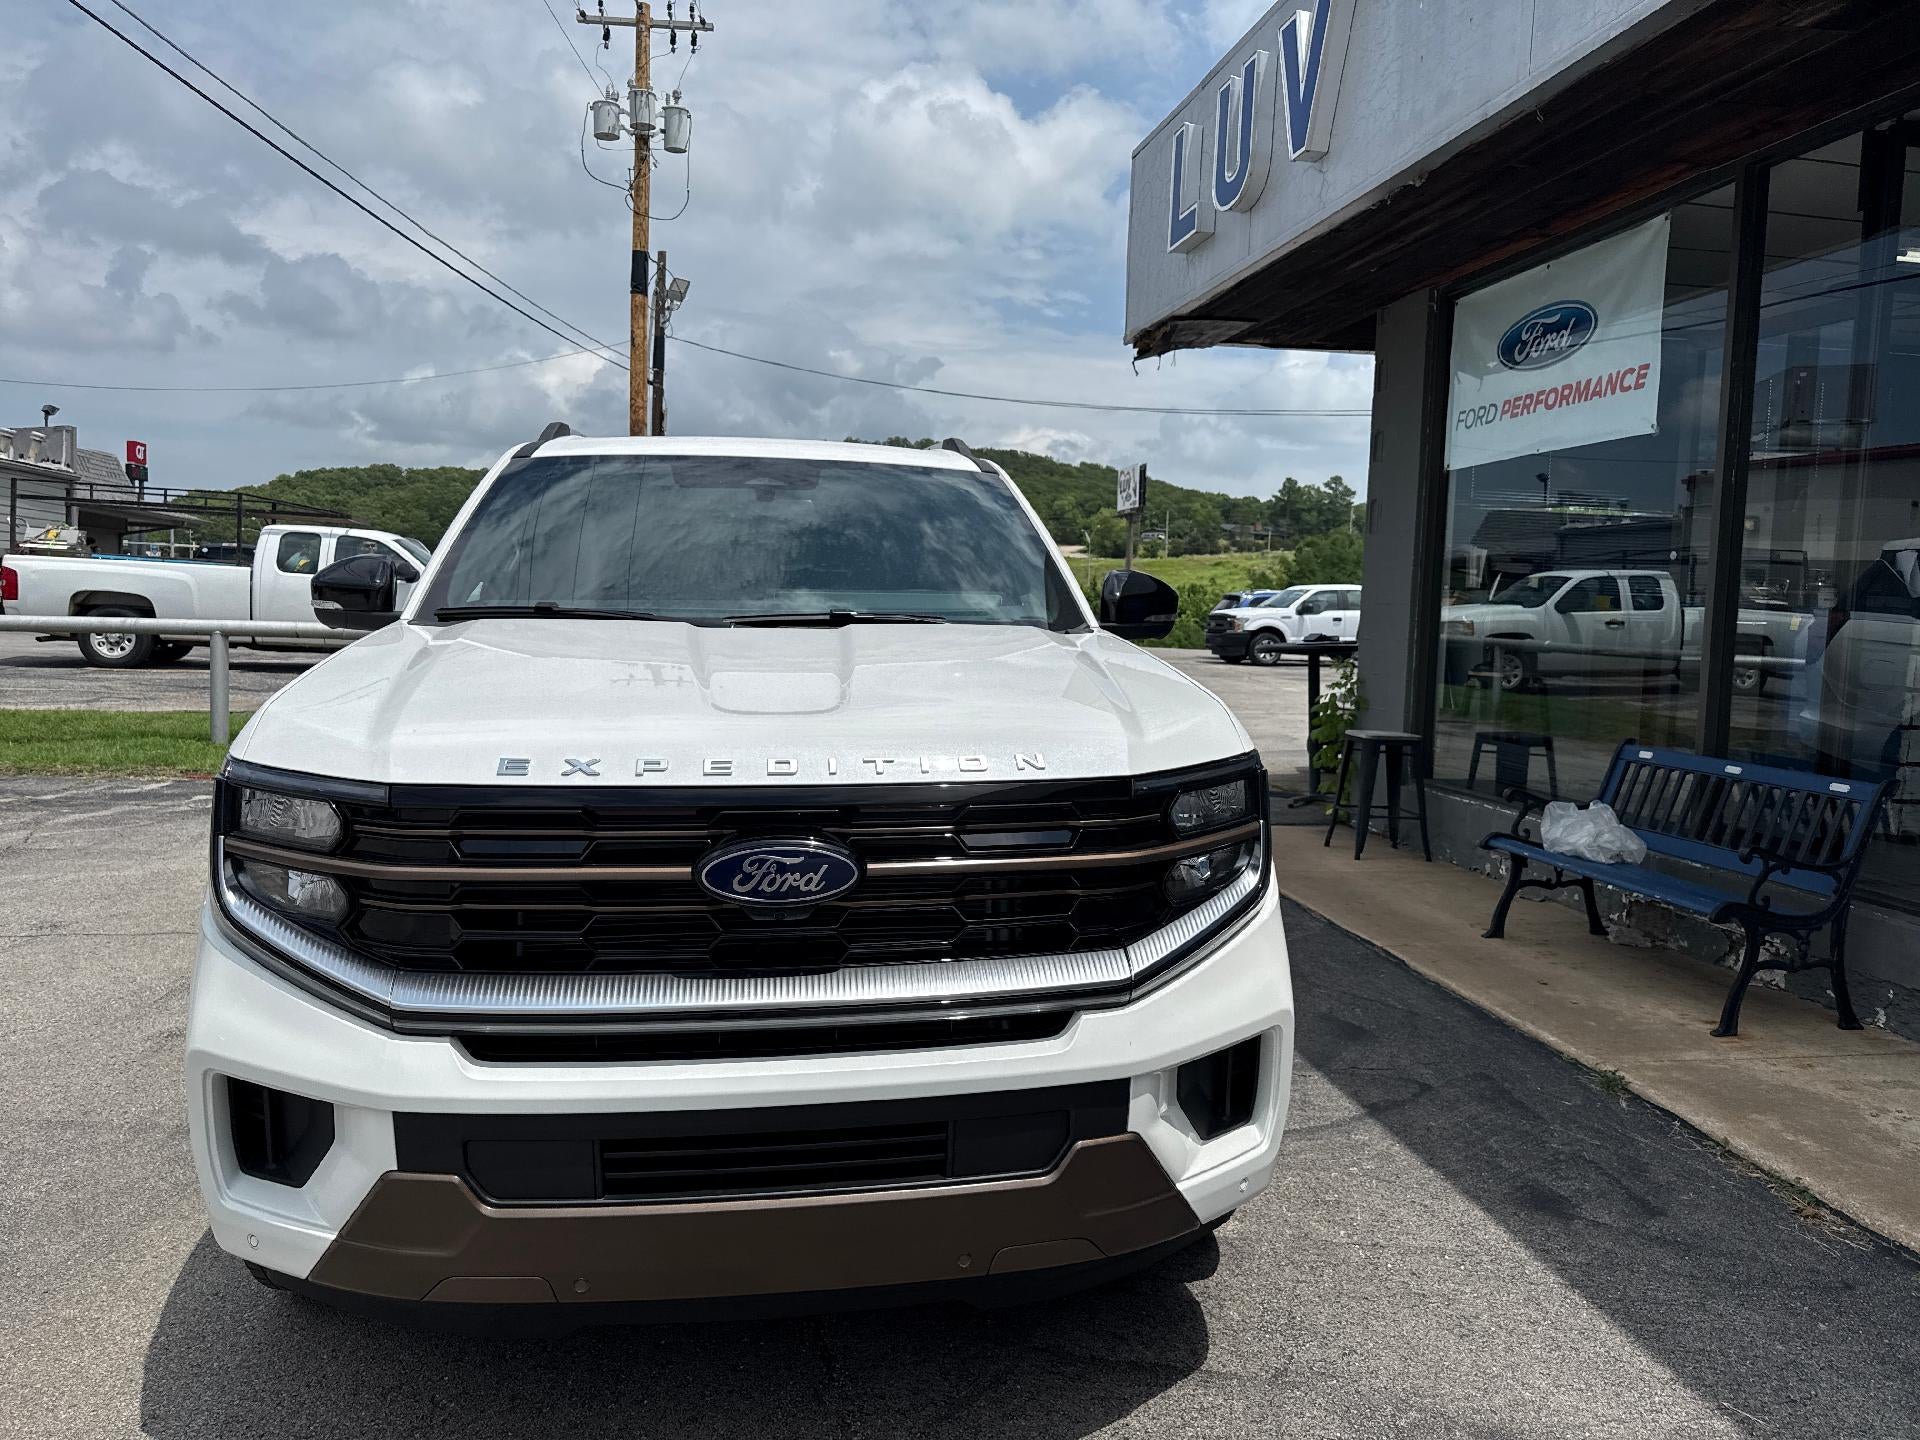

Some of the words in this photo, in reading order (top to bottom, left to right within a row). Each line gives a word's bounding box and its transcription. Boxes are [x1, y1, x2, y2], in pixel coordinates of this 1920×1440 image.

[1167, 0, 1338, 254] LUV
[1513, 312, 1577, 363] Ford
[1455, 403, 1499, 431] FORD
[1499, 362, 1652, 422] PERFORMANCE
[496, 752, 1047, 778] EXPEDITION
[731, 854, 829, 894] Ford
